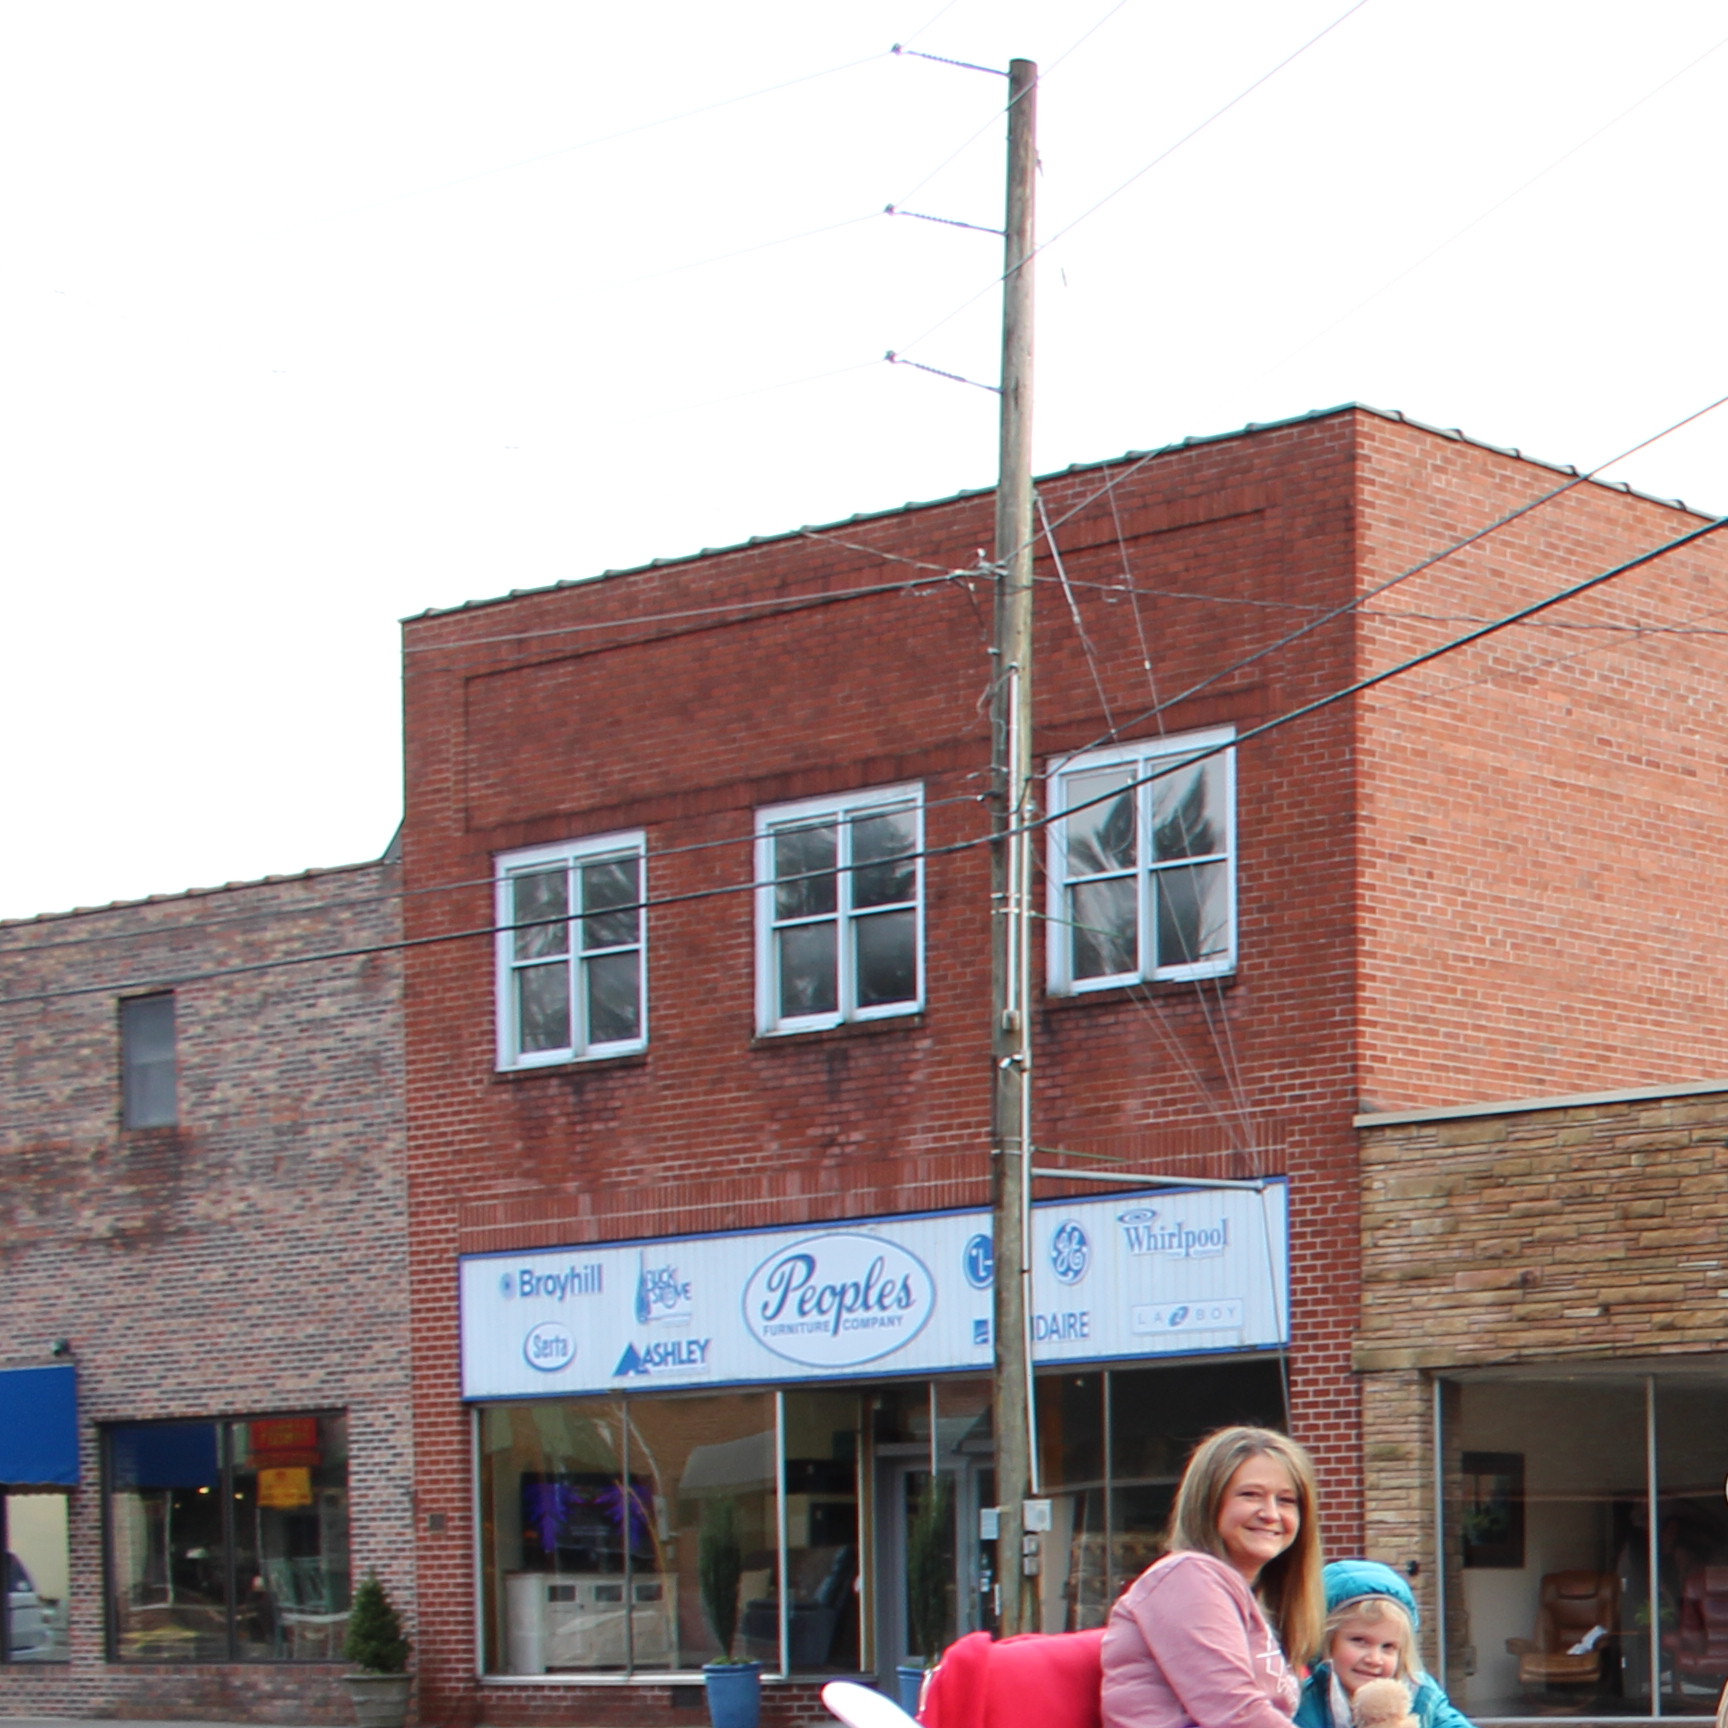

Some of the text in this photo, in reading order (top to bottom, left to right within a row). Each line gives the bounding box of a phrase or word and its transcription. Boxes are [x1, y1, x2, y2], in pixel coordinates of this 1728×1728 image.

[1124, 1218, 1229, 1258] Whirlpool
[518, 1264, 604, 1302] Broyhill
[761, 1252, 916, 1337] Peoples
[762, 1315, 903, 1337] FURNITURE COMPANY
[532, 1334, 568, 1360] Serta
[643, 1338, 711, 1367] ASHLEY
